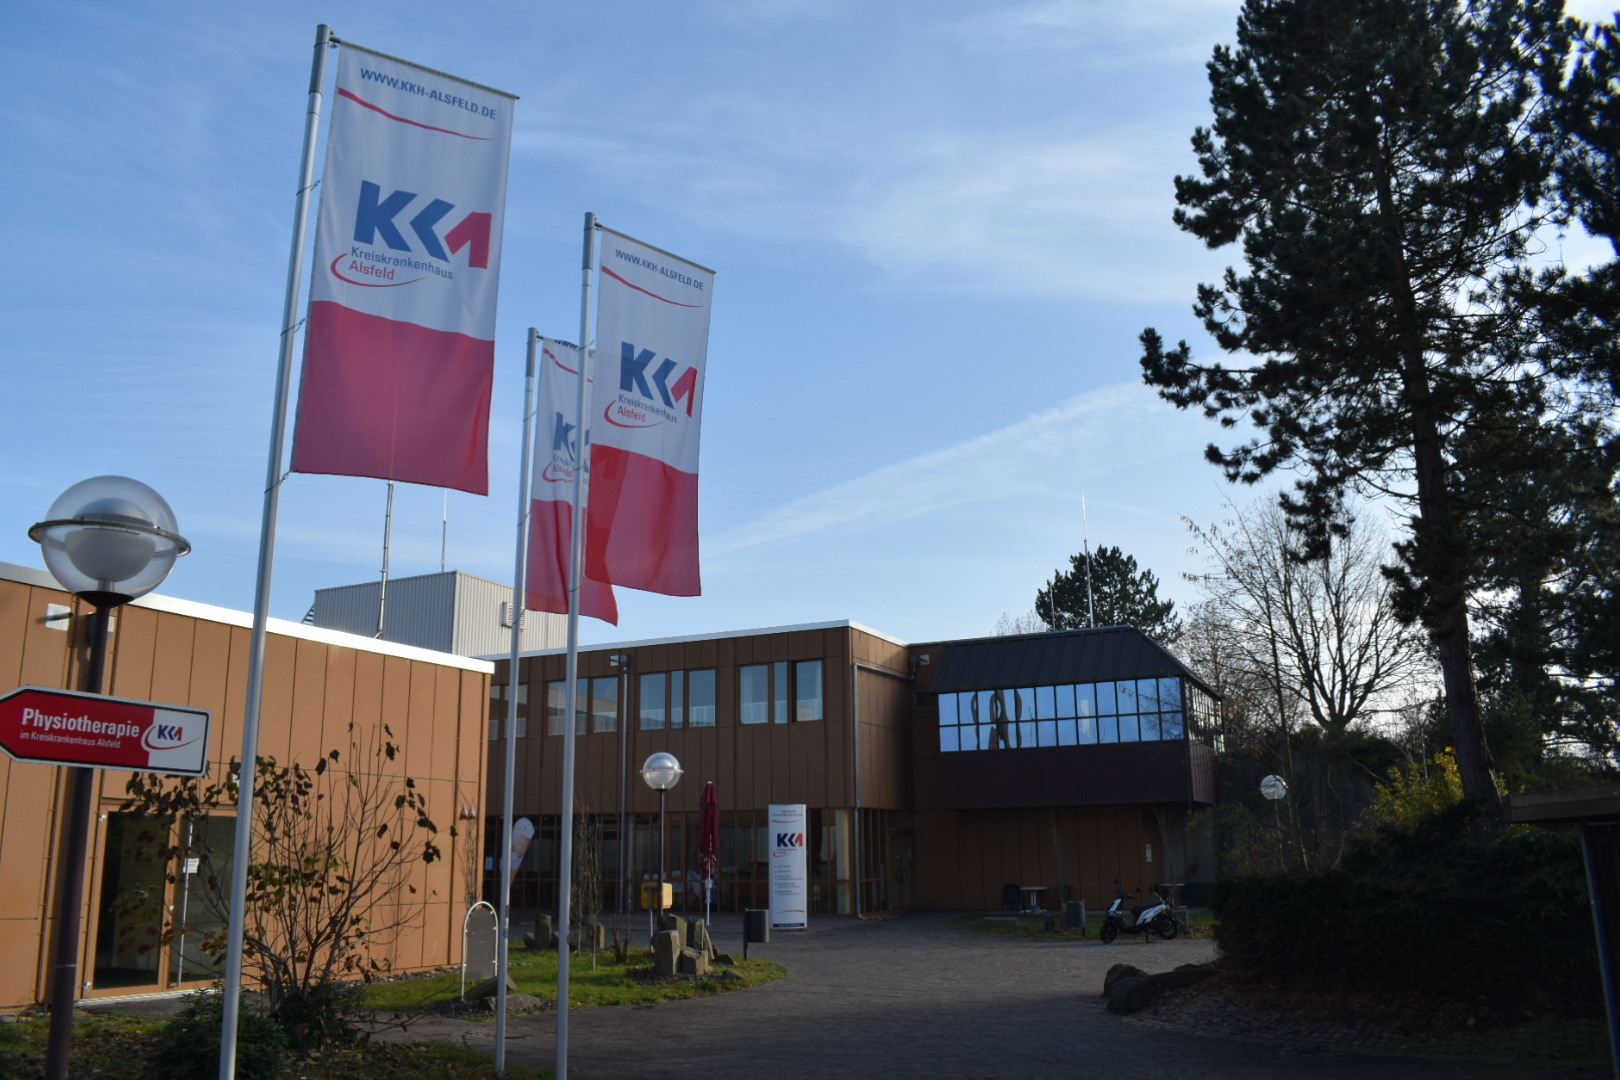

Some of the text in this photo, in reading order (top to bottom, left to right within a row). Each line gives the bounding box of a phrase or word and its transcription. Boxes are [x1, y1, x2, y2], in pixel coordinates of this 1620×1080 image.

[360, 68, 496, 120] WWW.KKH-ALSFELD.DE
[349, 260, 395, 280] Alsfeld
[350, 245, 454, 280] Kreiskrankenhaus
[615, 249, 704, 291] WWW.KKH-ALSFELD.DE
[617, 405, 646, 423] Alsfeld
[618, 393, 678, 423] Kreiskrankenhaus
[21, 707, 140, 738] Physiotherapie
[19, 730, 121, 749] im Kreiskrankenhaus Alsfeld
